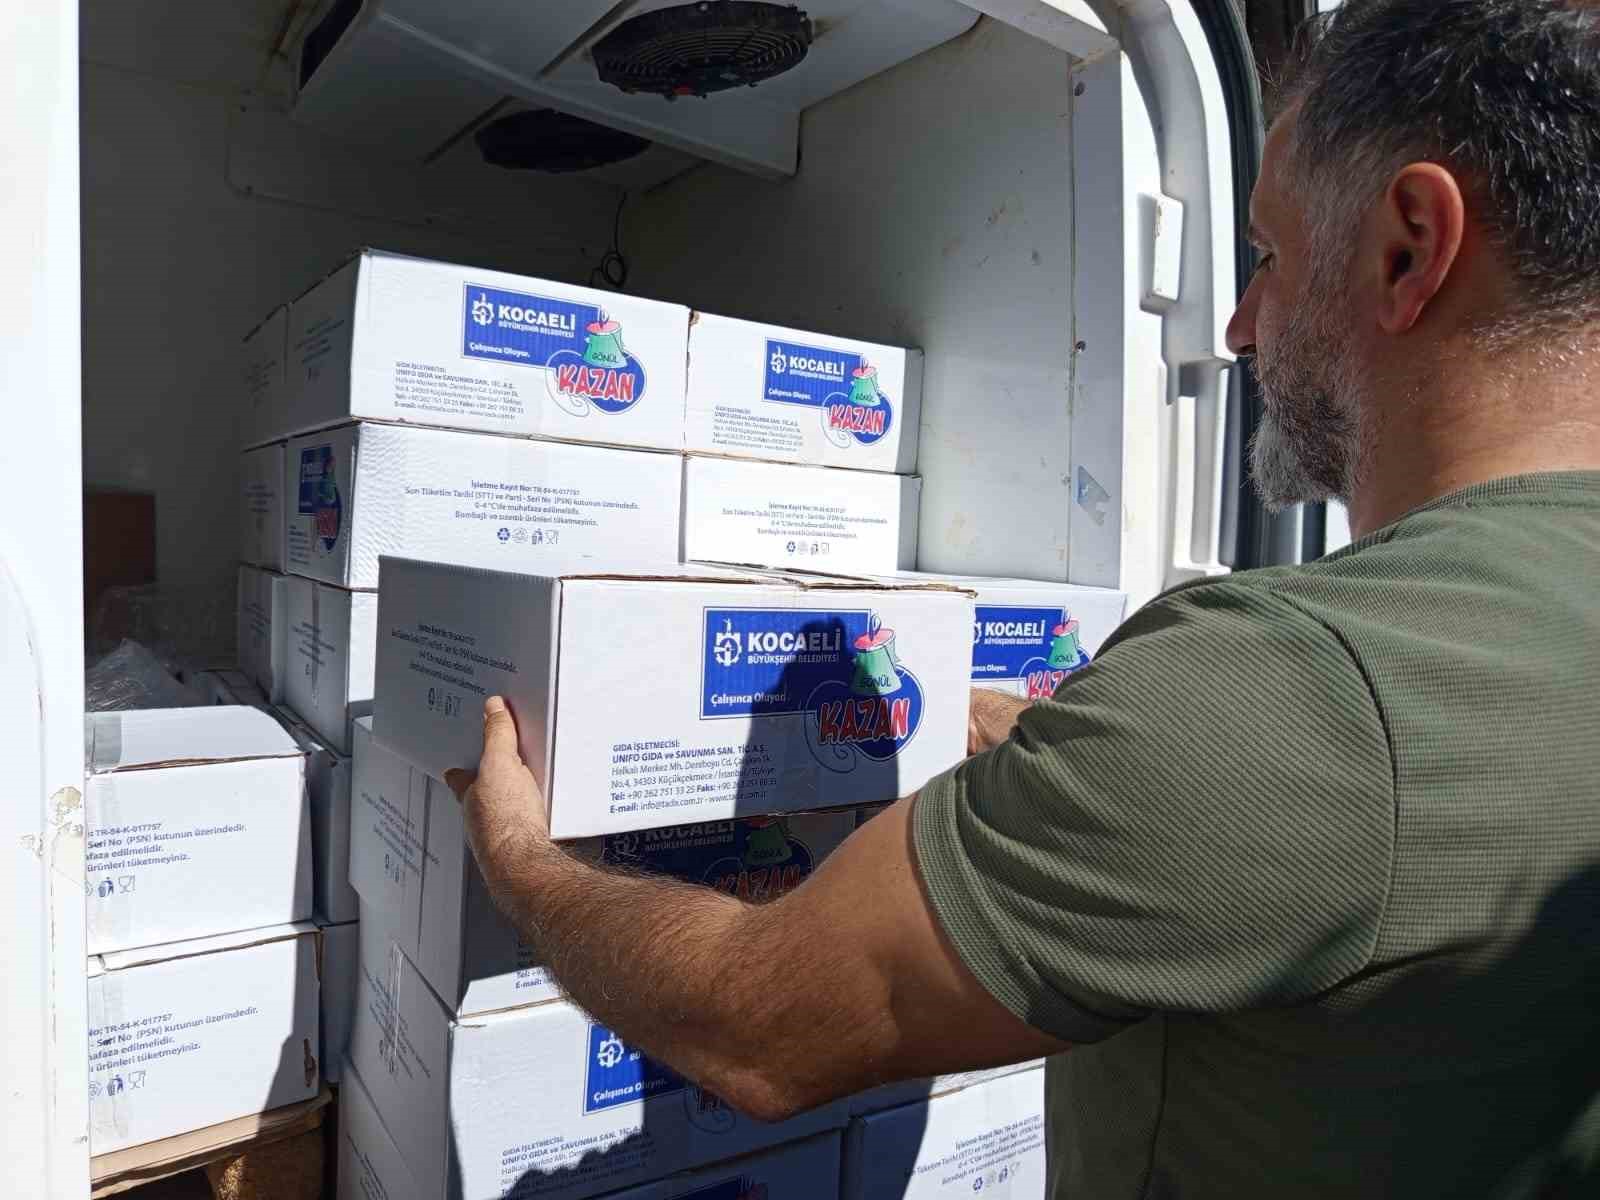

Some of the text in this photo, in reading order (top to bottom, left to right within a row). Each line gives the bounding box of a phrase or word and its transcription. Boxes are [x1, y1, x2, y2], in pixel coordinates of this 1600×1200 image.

[499, 305, 576, 331] KOCAELİ
[790, 356, 845, 376] KOCAELİ
[558, 364, 636, 403] KAZAN
[830, 405, 886, 436] KAZAN
[984, 619, 1045, 637] KOCAELİ
[748, 628, 841, 653] KOCAELİ
[747, 653, 840, 666] BÜYÜKŞEHİR BELEDİYESİ
[862, 673, 892, 688] GÖNÜL
[710, 693, 752, 707] Çalışınca
[817, 697, 910, 745] KAZAN
[613, 739, 681, 753] GIDA İŞLETMECİSİ:
[641, 751, 663, 761] GIDA
[675, 748, 716, 759] SAVUNMA
[717, 746, 735, 755] SAN.
[611, 792, 625, 801] Tel:
[626, 790, 642, 800] +90
[643, 788, 659, 798] 262
[696, 783, 716, 793] Faks:
[610, 803, 638, 815] E-mail:
[87, 823, 247, 849] Seri No (PSN) kutunun üzerindedir.
[111, 845, 164, 859] edilmelidir.
[87, 853, 191, 872] ürünleri tüketmeyiniz.
[515, 979, 542, 989] E-mail:
[117, 1033, 132, 1043] No
[136, 1028, 163, 1040] (PSN)
[164, 1018, 204, 1033] kutunun
[205, 1006, 259, 1024] üzerindedir.
[121, 1036, 176, 1055] edilmelidir.
[96, 1056, 136, 1072] ürünleri
[137, 1041, 201, 1063] tüketmeyiniz.
[593, 1084, 634, 1104] Çalışınca
